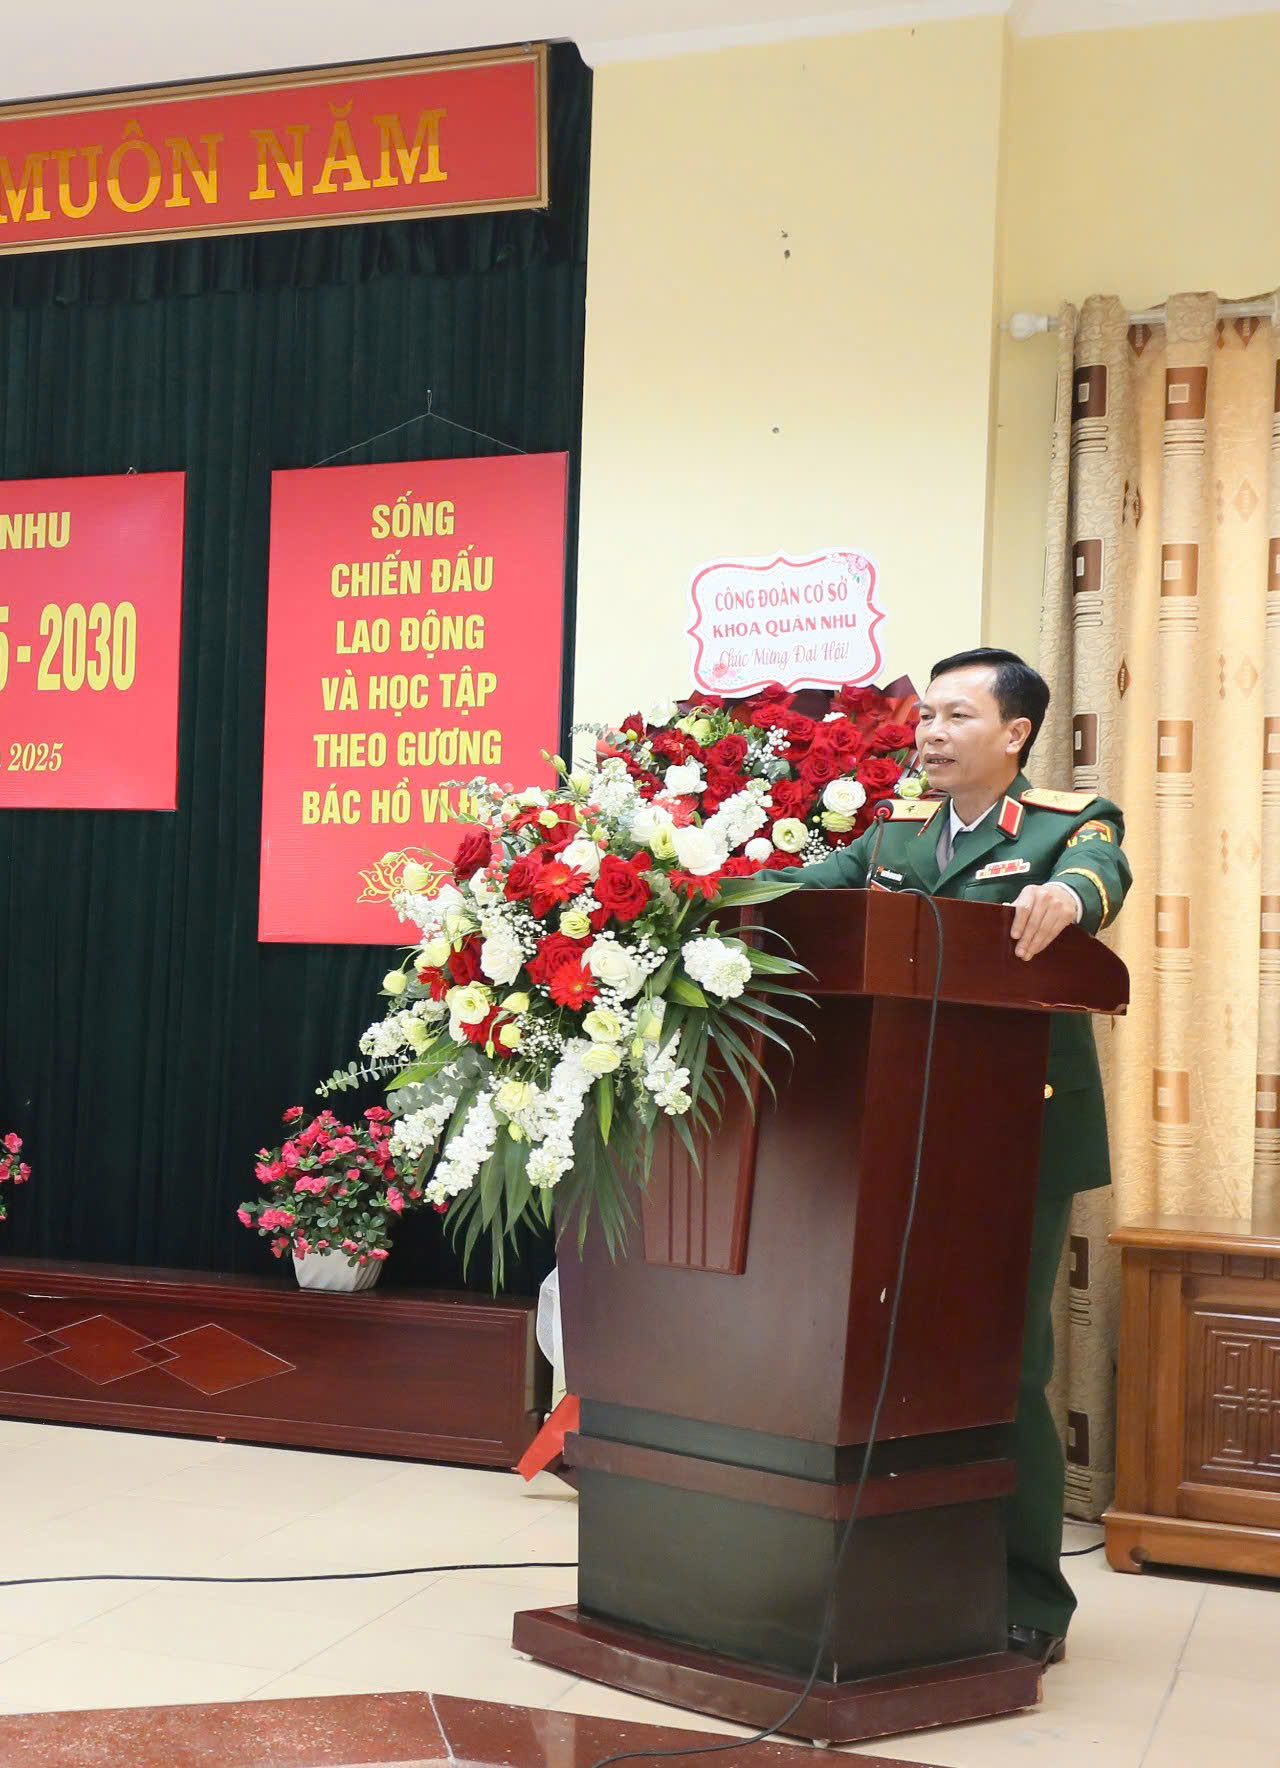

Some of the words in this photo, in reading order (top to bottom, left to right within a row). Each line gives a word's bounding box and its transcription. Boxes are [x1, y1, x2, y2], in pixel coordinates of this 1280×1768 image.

[248, 97, 449, 201] NĂM
[371, 490, 456, 539] SỐNG
[330, 549, 422, 598] CHIẾN
[431, 544, 494, 593] ĐẤU
[715, 586, 755, 612] CÔNG
[758, 582, 800, 608] ĐOÀN
[335, 617, 392, 655] LAO
[399, 608, 486, 660] ĐỘNG
[712, 621, 762, 639] KHOA
[765, 614, 817, 638] QUÂN
[820, 613, 857, 630] NHU
[321, 668, 360, 713] VÀ
[368, 672, 430, 717] HỌC
[438, 665, 498, 716] TẬP
[6, 742, 64, 773] 2025
[313, 732, 387, 769] THEO
[396, 727, 503, 767] GƯƠNG
[301, 783, 362, 825] BÁC
[371, 776, 412, 824] HỒ
